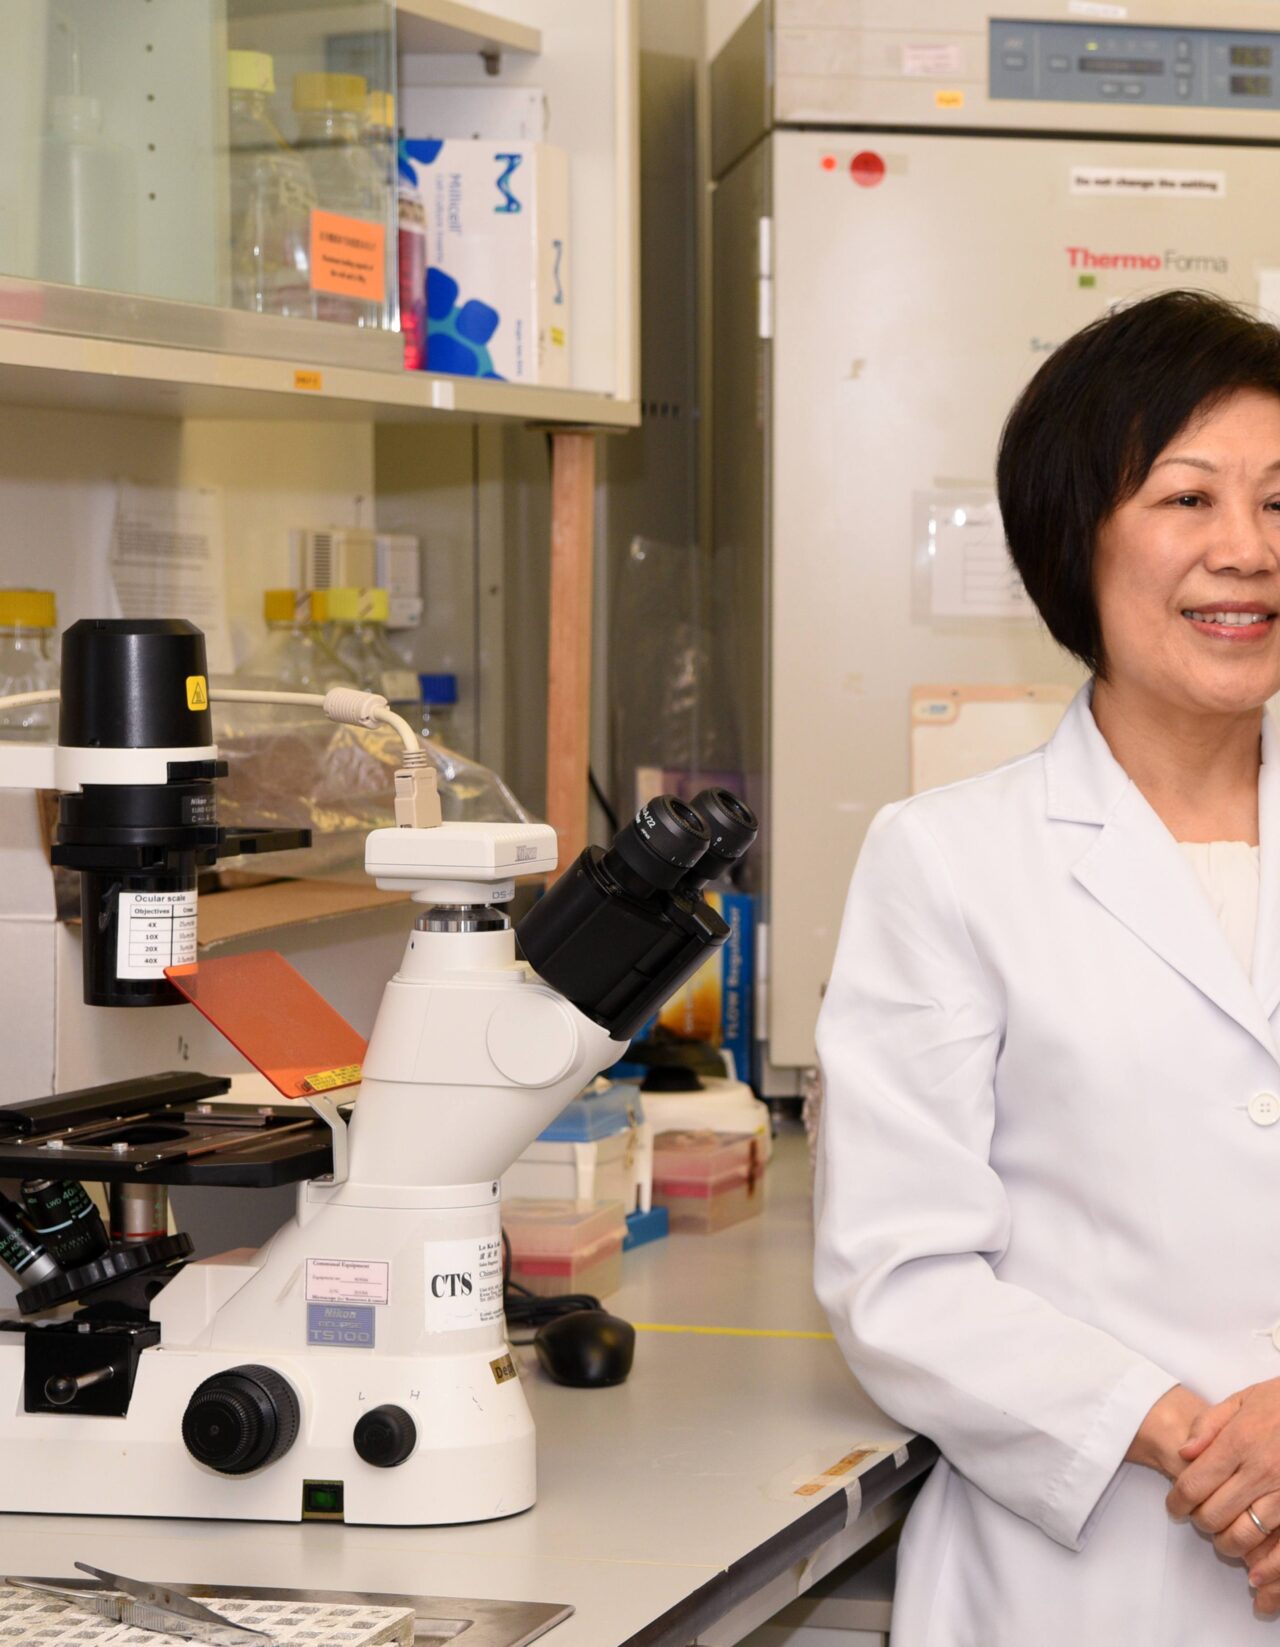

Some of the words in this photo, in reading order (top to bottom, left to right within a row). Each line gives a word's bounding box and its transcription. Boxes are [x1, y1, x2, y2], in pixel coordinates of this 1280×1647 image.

[1076, 177, 1089, 186] Do
[1116, 177, 1154, 190] change
[1160, 178, 1175, 188] the
[1066, 247, 1162, 271] Thermo
[1164, 249, 1229, 273] Forma
[134, 894, 165, 903] Ocular
[167, 894, 186, 902] scale
[341, 1261, 369, 1269] Equipment
[431, 1271, 473, 1298] CTS
[324, 1308, 357, 1319] Nikon
[310, 1329, 370, 1342] TS100
